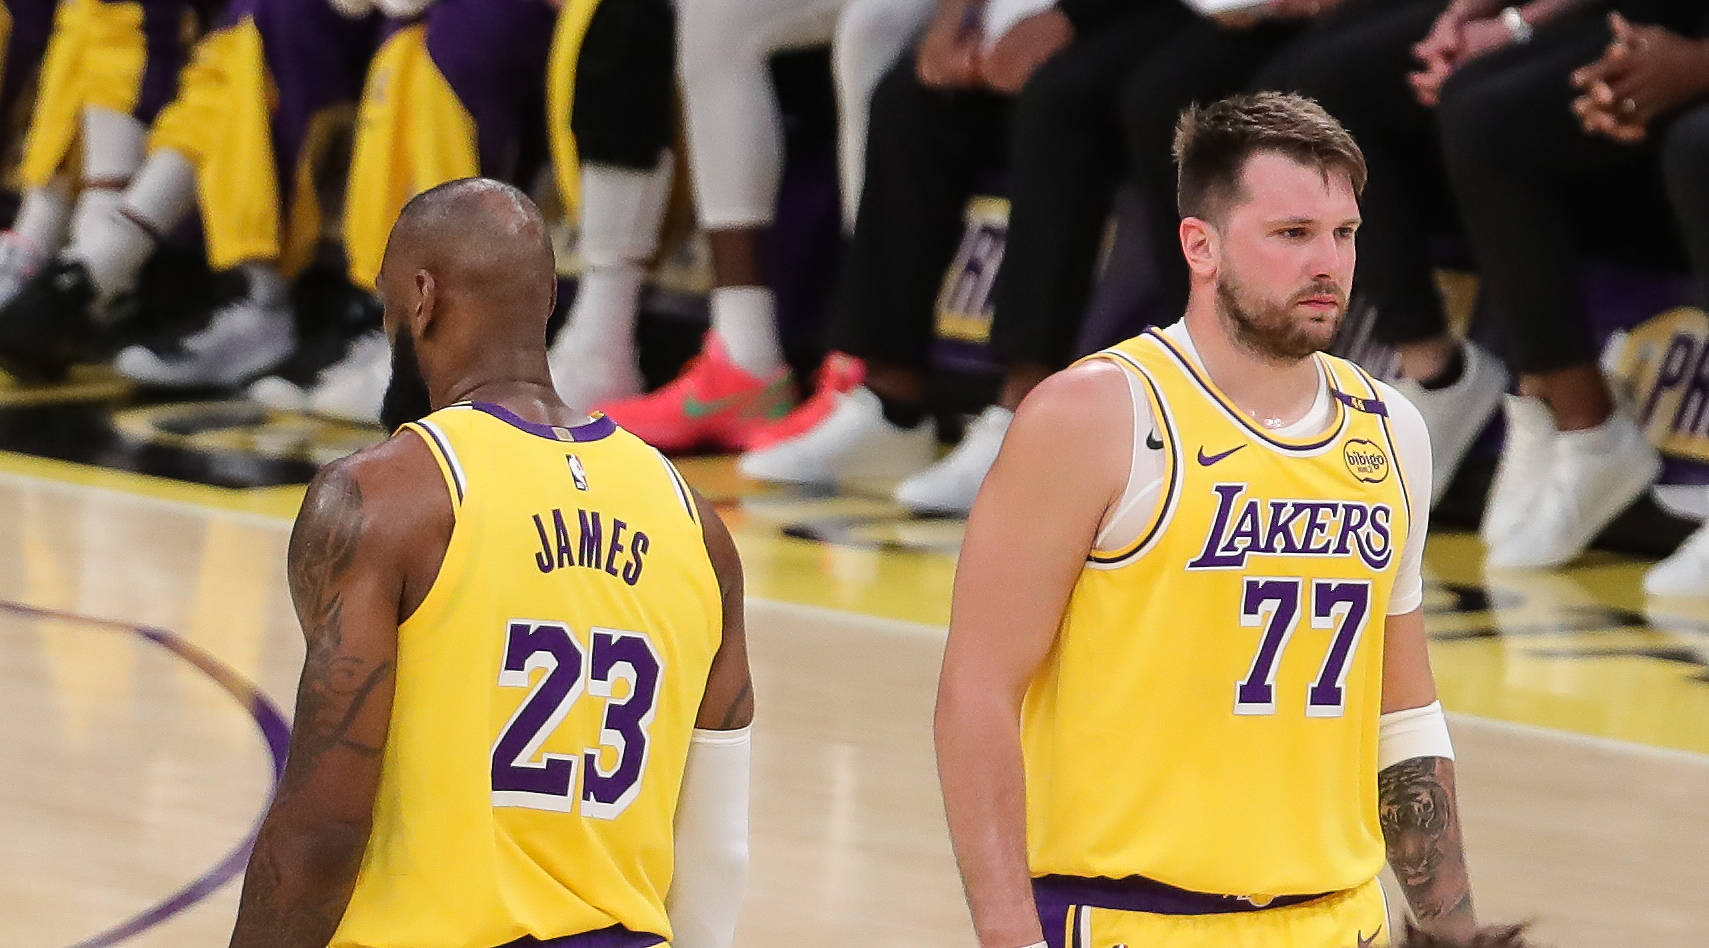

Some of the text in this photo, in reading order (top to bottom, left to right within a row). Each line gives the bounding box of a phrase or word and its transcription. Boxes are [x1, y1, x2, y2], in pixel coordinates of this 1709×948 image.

[1346, 450, 1385, 469] bibigo
[532, 508, 650, 586] JAMES
[1185, 482, 1393, 572] LAKERS
[1234, 577, 1373, 718] 77
[491, 618, 664, 820] 23
